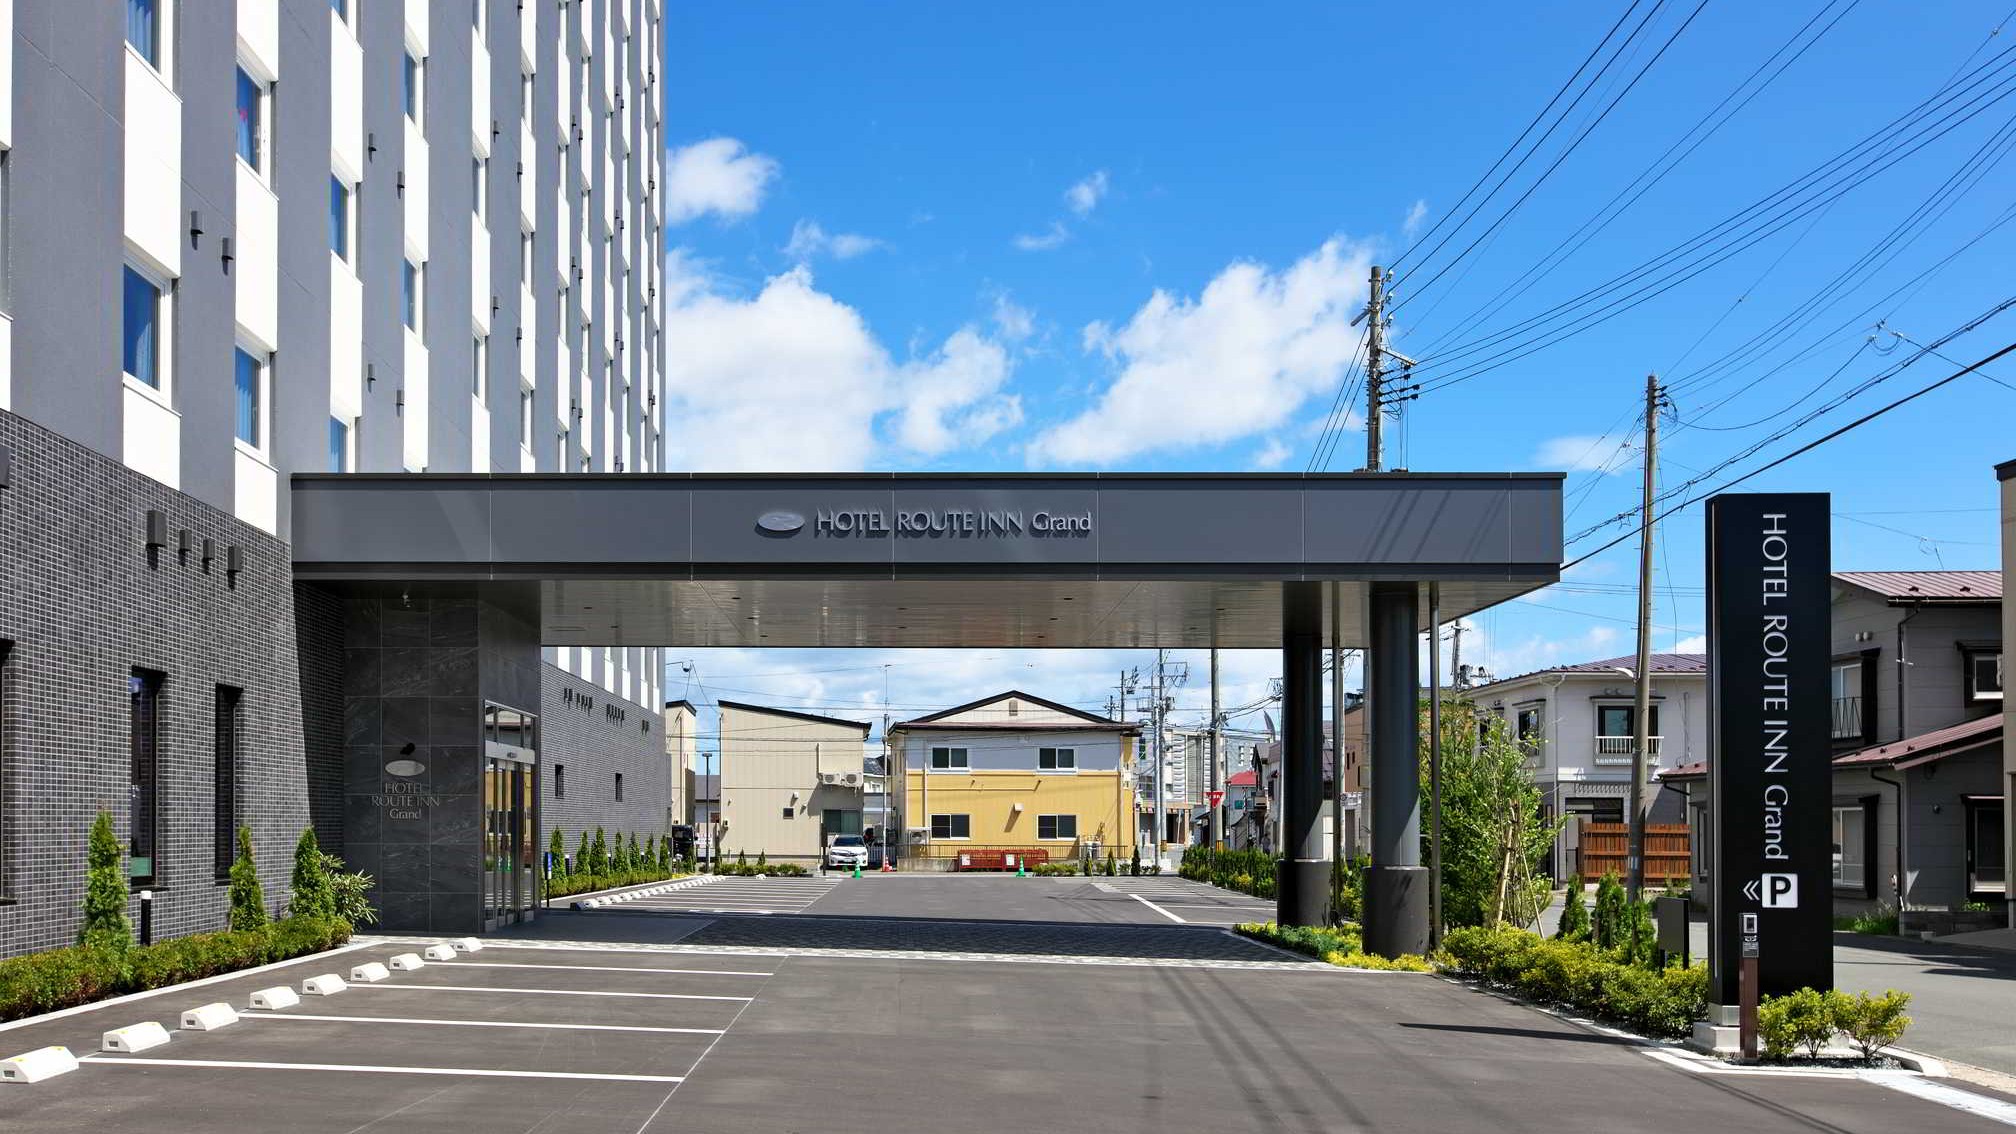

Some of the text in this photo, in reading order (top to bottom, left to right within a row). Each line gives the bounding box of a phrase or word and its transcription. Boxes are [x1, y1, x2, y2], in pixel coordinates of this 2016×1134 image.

[817, 509, 1092, 531] HOTEL ROUTE INN Grand
[1762, 513, 1789, 860] HOTEL ROUTE INN Grand
[371, 795, 441, 807] ROUTE INN
[389, 808, 422, 819] Grand
[1770, 875, 1792, 906] P
